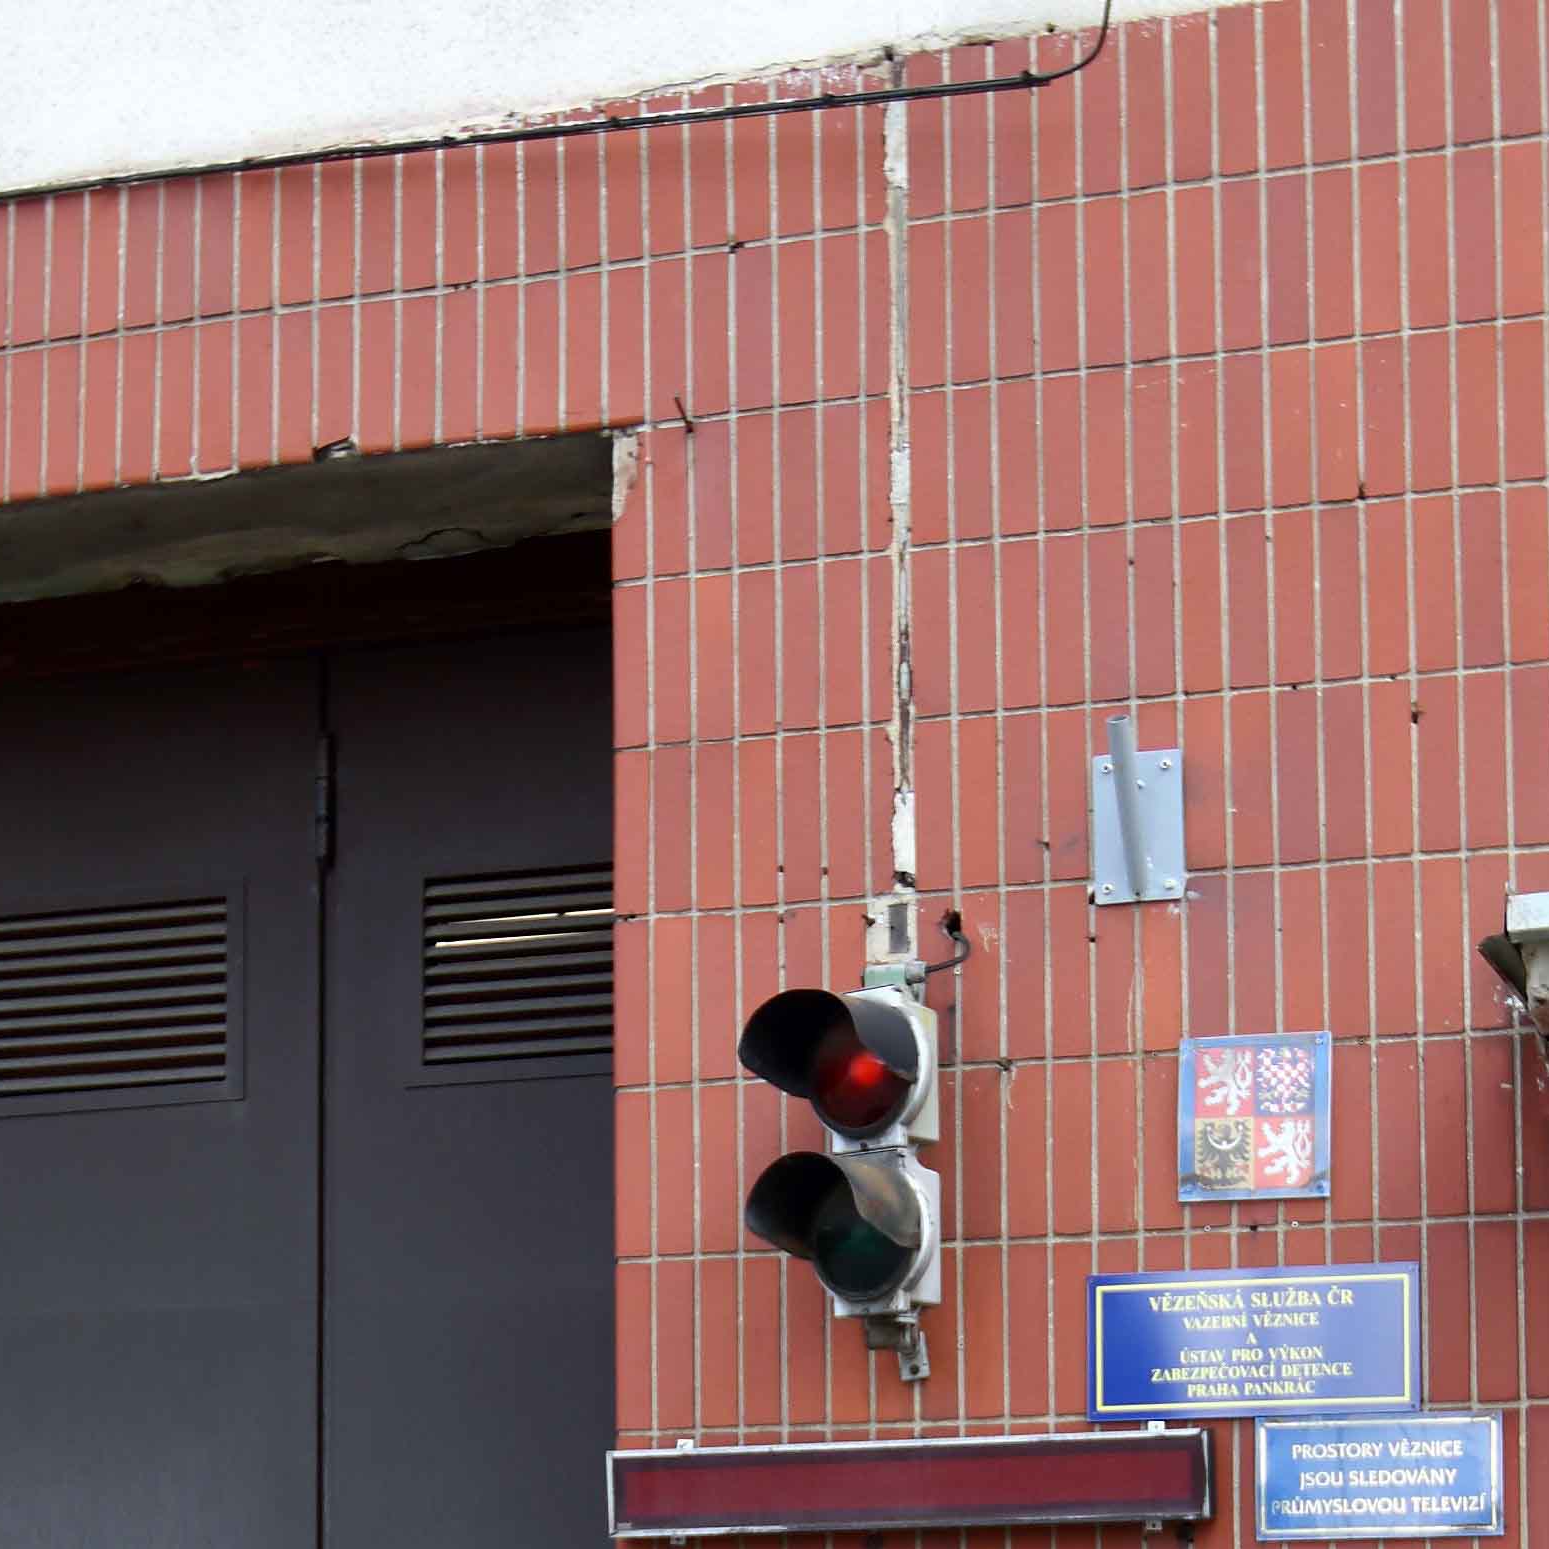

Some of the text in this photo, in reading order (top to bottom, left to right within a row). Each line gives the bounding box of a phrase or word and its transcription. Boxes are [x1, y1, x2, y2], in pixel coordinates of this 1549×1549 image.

[1149, 1285, 1355, 1312] VĚZEŇSKÁ SLUŽBA ČR
[1182, 1310, 1320, 1330] VAZEBNÍ VĚZNICE
[1246, 1331, 1258, 1345] A
[1179, 1343, 1324, 1364] ÚSTAV PRO VÝKON
[1151, 1360, 1354, 1383] ZABEZPEČOVACÍ DETENCE
[1187, 1376, 1317, 1398] PRAHA PANKRÁC
[1291, 1438, 1464, 1461] PROSTORY VĚZNICE
[1299, 1465, 1458, 1491] JSOU SLEDOVÁNY
[1271, 1492, 1487, 1515] PRŮMYSLOVOU TELEVIZÍ
